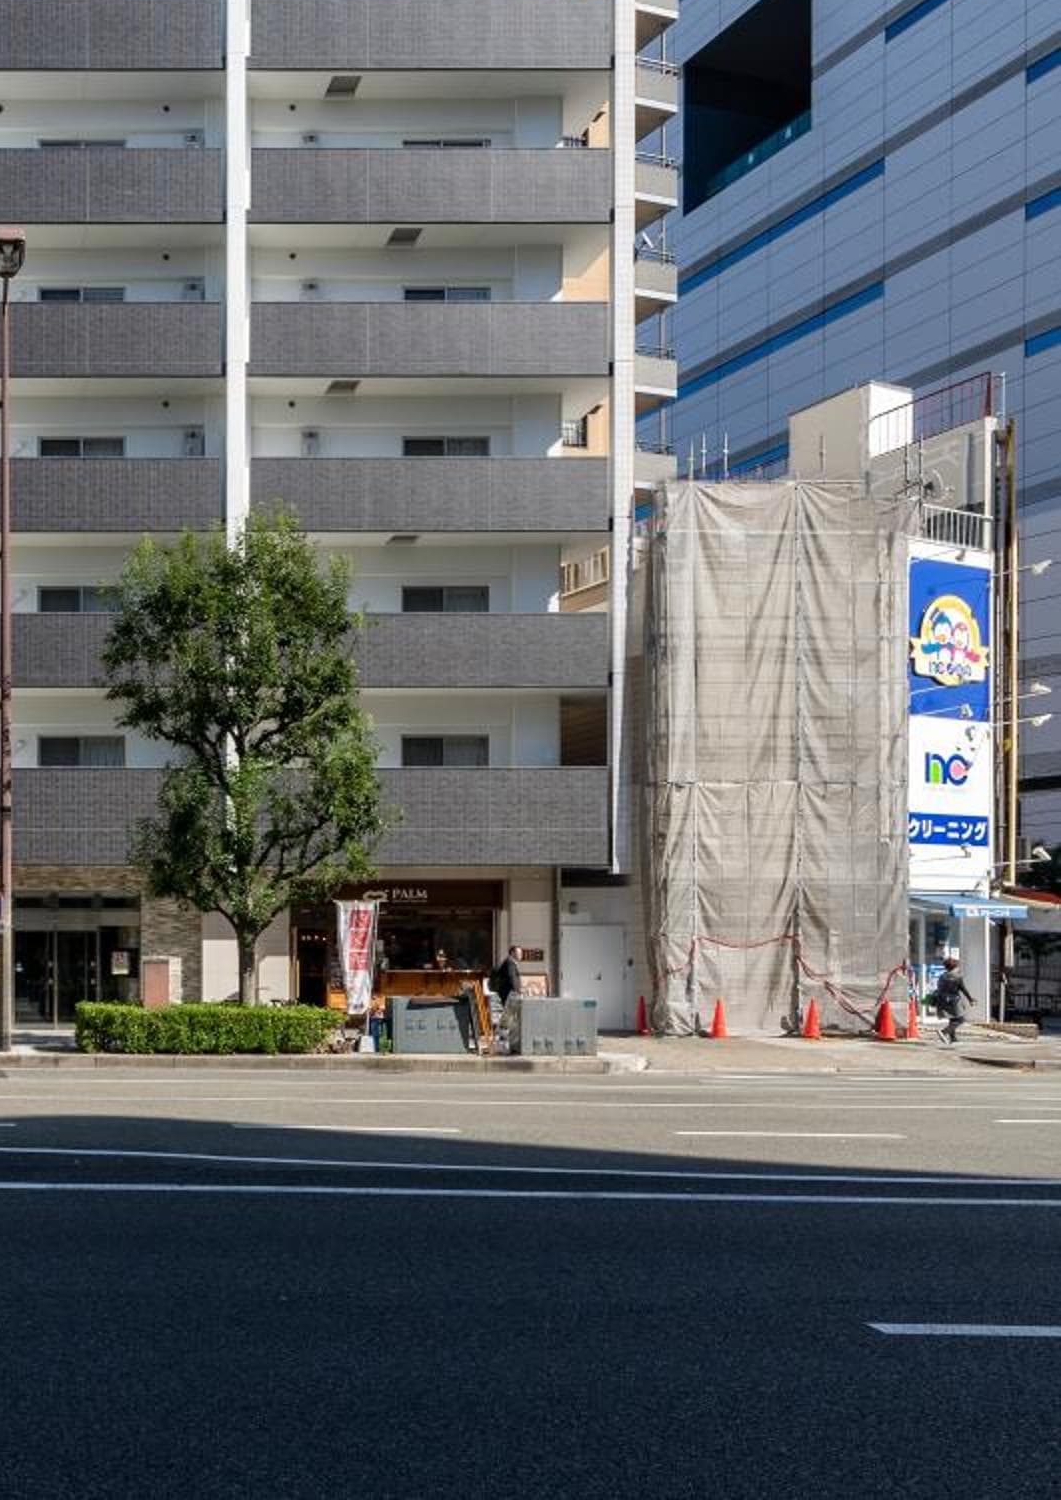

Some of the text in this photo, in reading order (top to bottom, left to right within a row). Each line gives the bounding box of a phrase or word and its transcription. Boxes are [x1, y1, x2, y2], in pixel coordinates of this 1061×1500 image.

[909, 818, 987, 841] クリーニング
[392, 887, 428, 899] PALM
